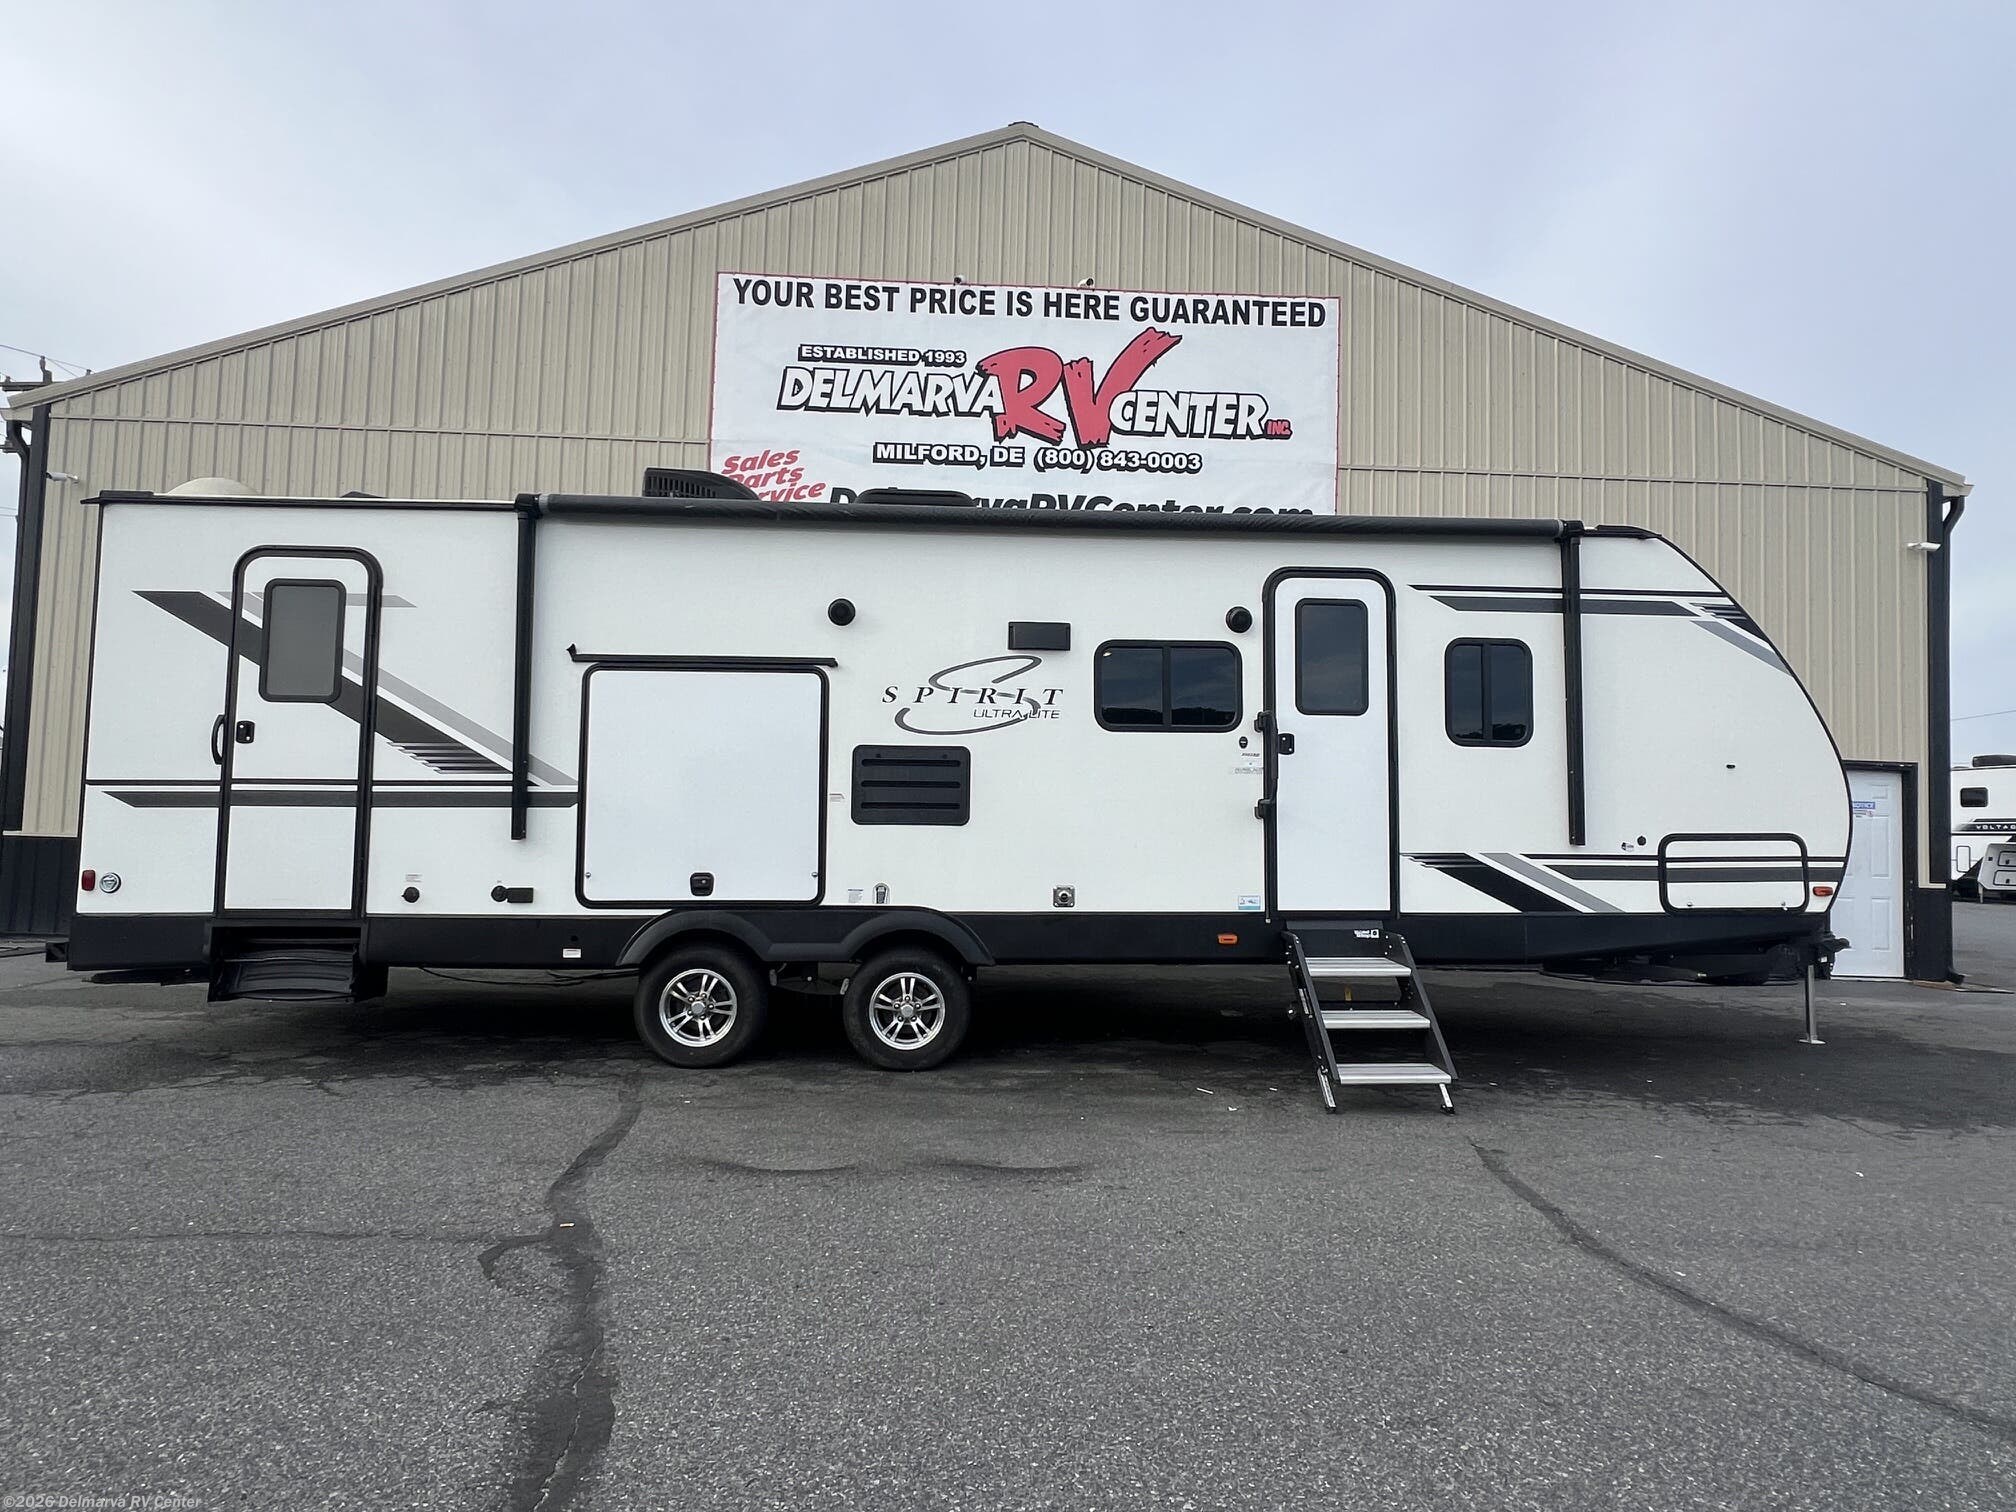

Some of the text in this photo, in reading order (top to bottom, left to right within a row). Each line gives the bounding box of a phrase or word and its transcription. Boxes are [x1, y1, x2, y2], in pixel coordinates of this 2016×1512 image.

[733, 278, 1326, 327] YOUR BEST PRICE IS HERE GUARANTEED
[800, 345, 966, 366] ESTABLISHED 1993
[779, 367, 1005, 416] DELMARVA
[976, 327, 1182, 450] RV
[1109, 390, 1268, 438] CENTER
[875, 443, 1204, 473] MILFORD, DE (800) 843-0003
[882, 685, 1064, 706] SPIRIT
